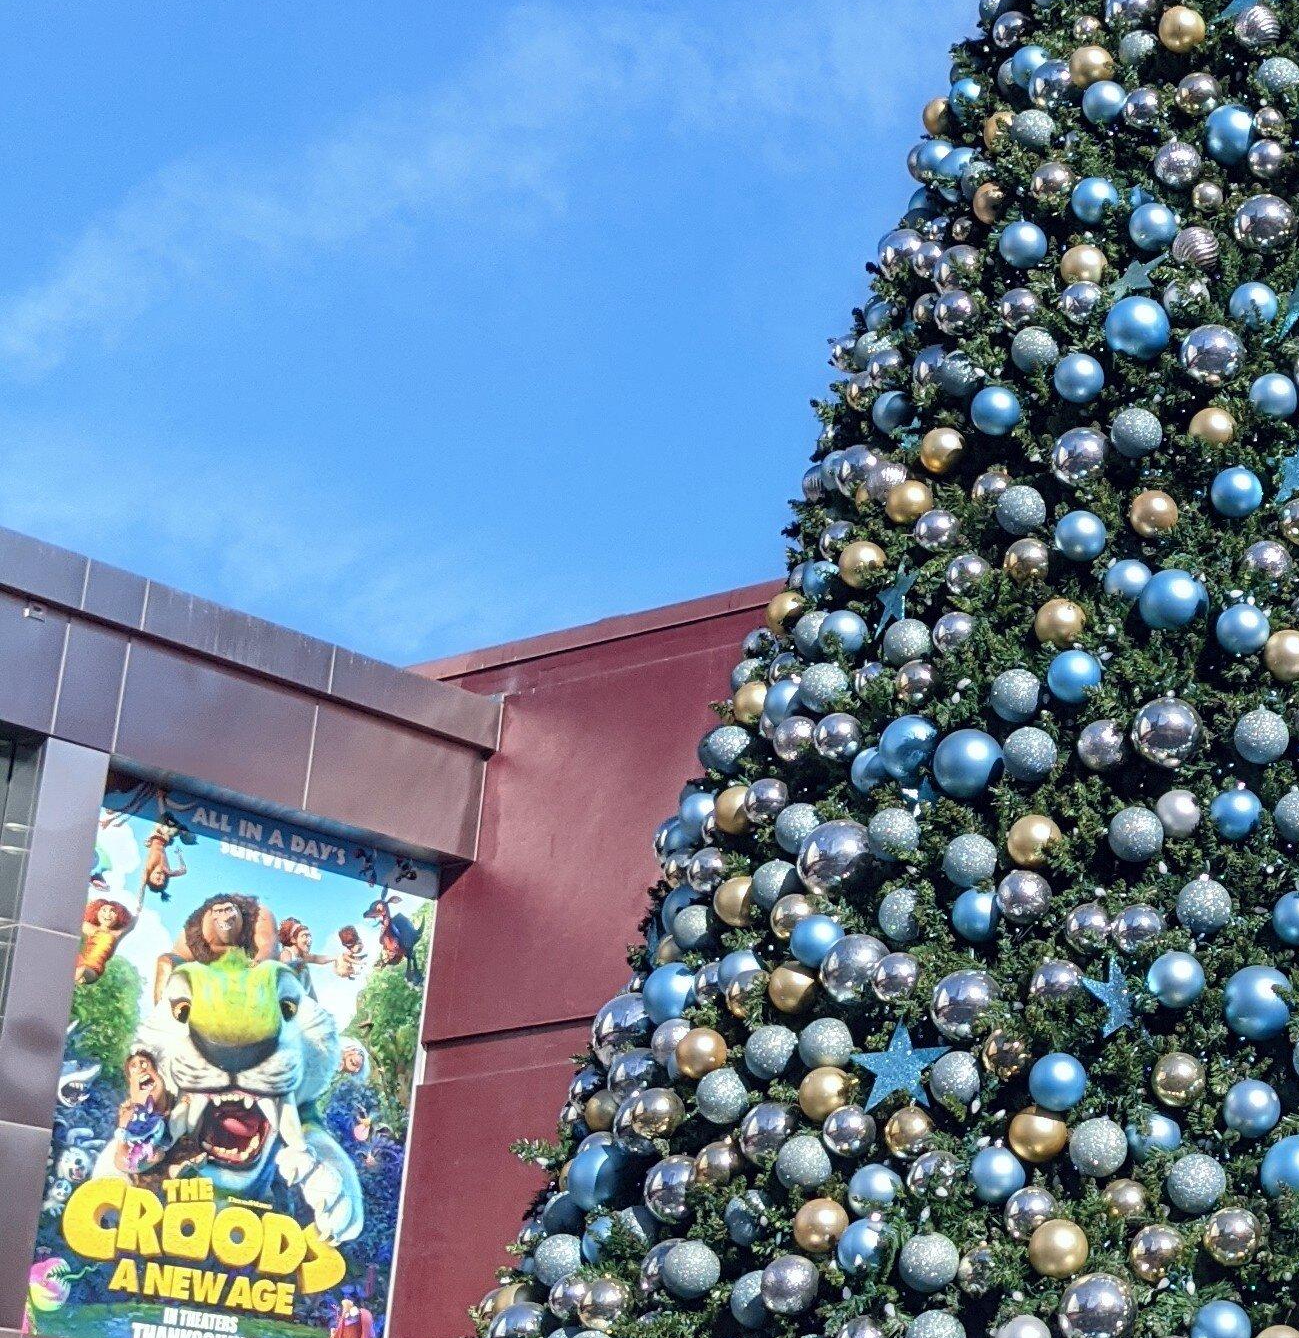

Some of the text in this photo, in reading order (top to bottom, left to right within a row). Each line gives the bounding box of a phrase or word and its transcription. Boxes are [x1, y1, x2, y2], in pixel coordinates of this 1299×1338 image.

[192, 807, 346, 865] ALL IN A DAY'S
[219, 836, 322, 881] SURVIVAL
[162, 1178, 214, 1202] THE
[62, 1177, 347, 1294] CROODS
[109, 1258, 296, 1315] A NEW AGE
[163, 1307, 239, 1334] IN THEATERS
